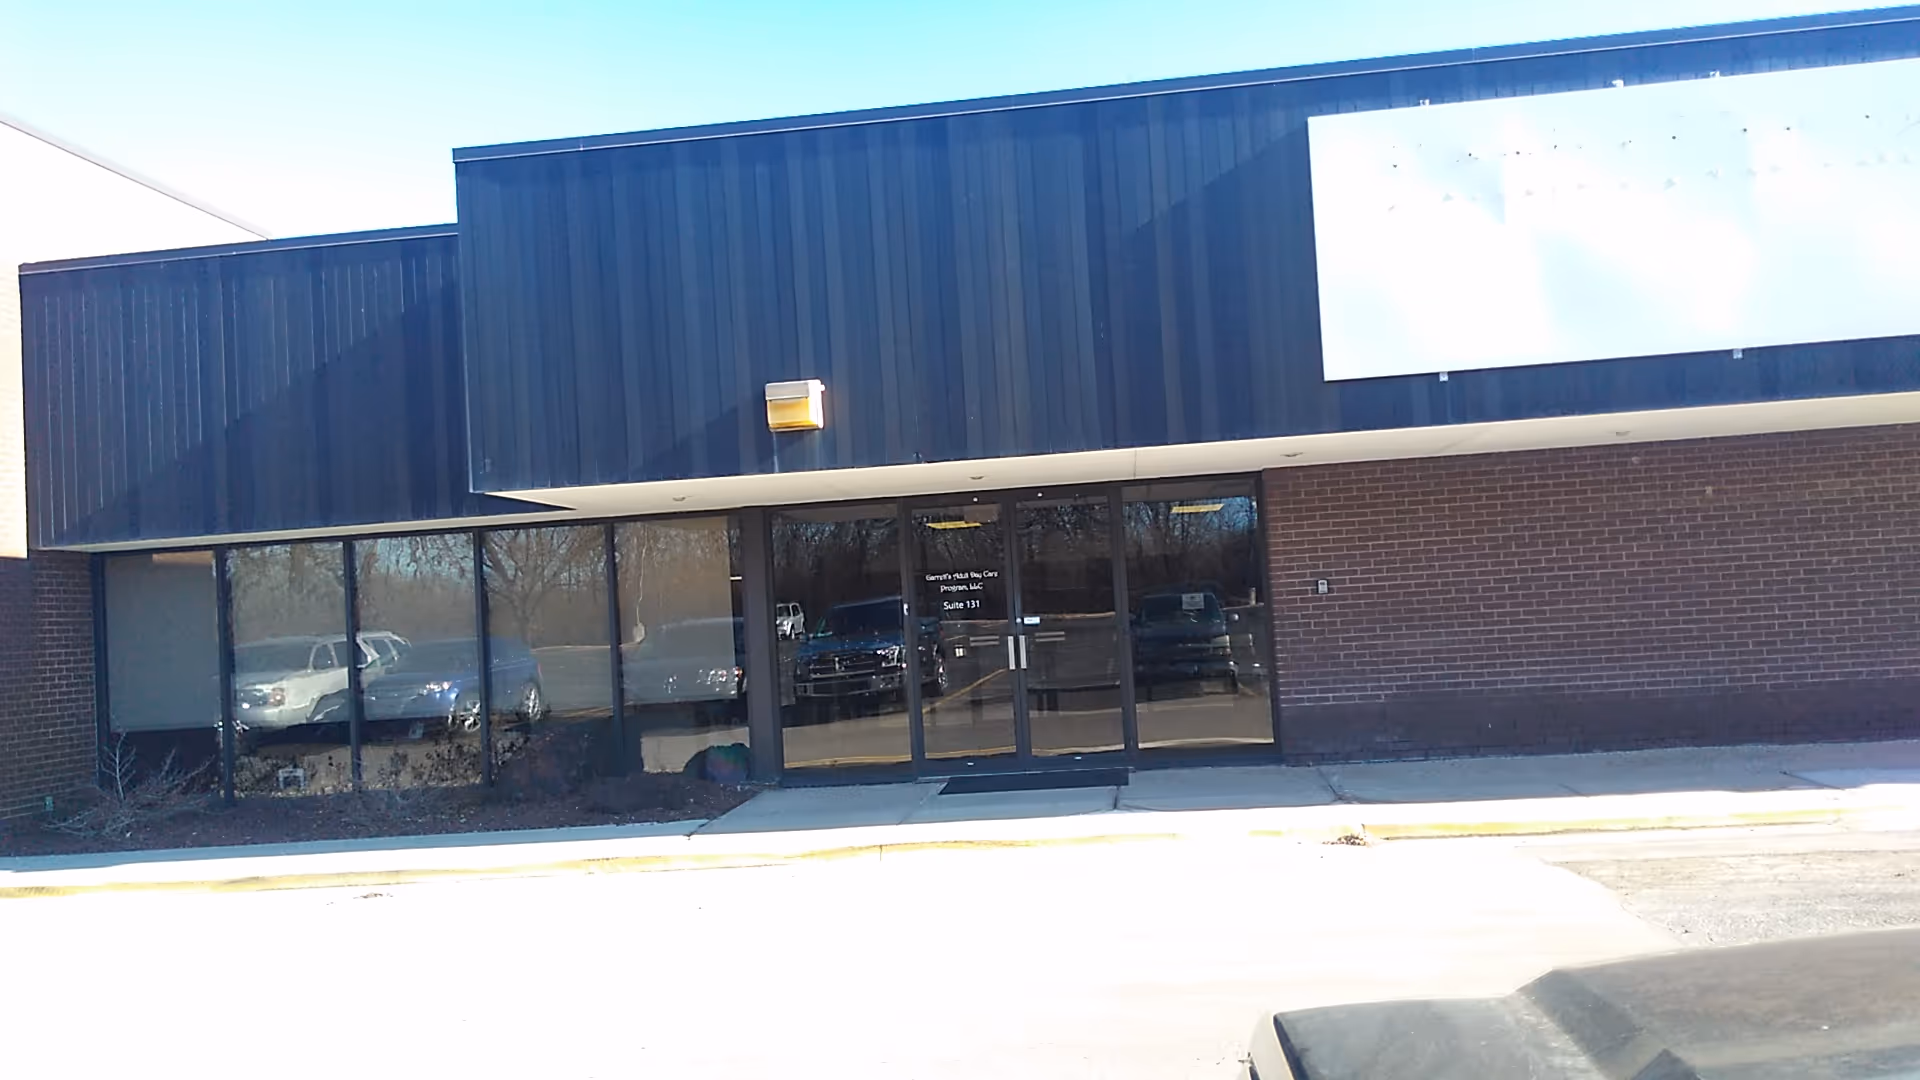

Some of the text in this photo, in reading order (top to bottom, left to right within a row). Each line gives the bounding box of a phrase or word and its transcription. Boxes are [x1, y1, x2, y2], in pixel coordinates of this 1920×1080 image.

[970, 571, 982, 579] Day
[983, 570, 998, 578] Care
[969, 582, 983, 590] LLC
[943, 600, 980, 610] Suite 131
